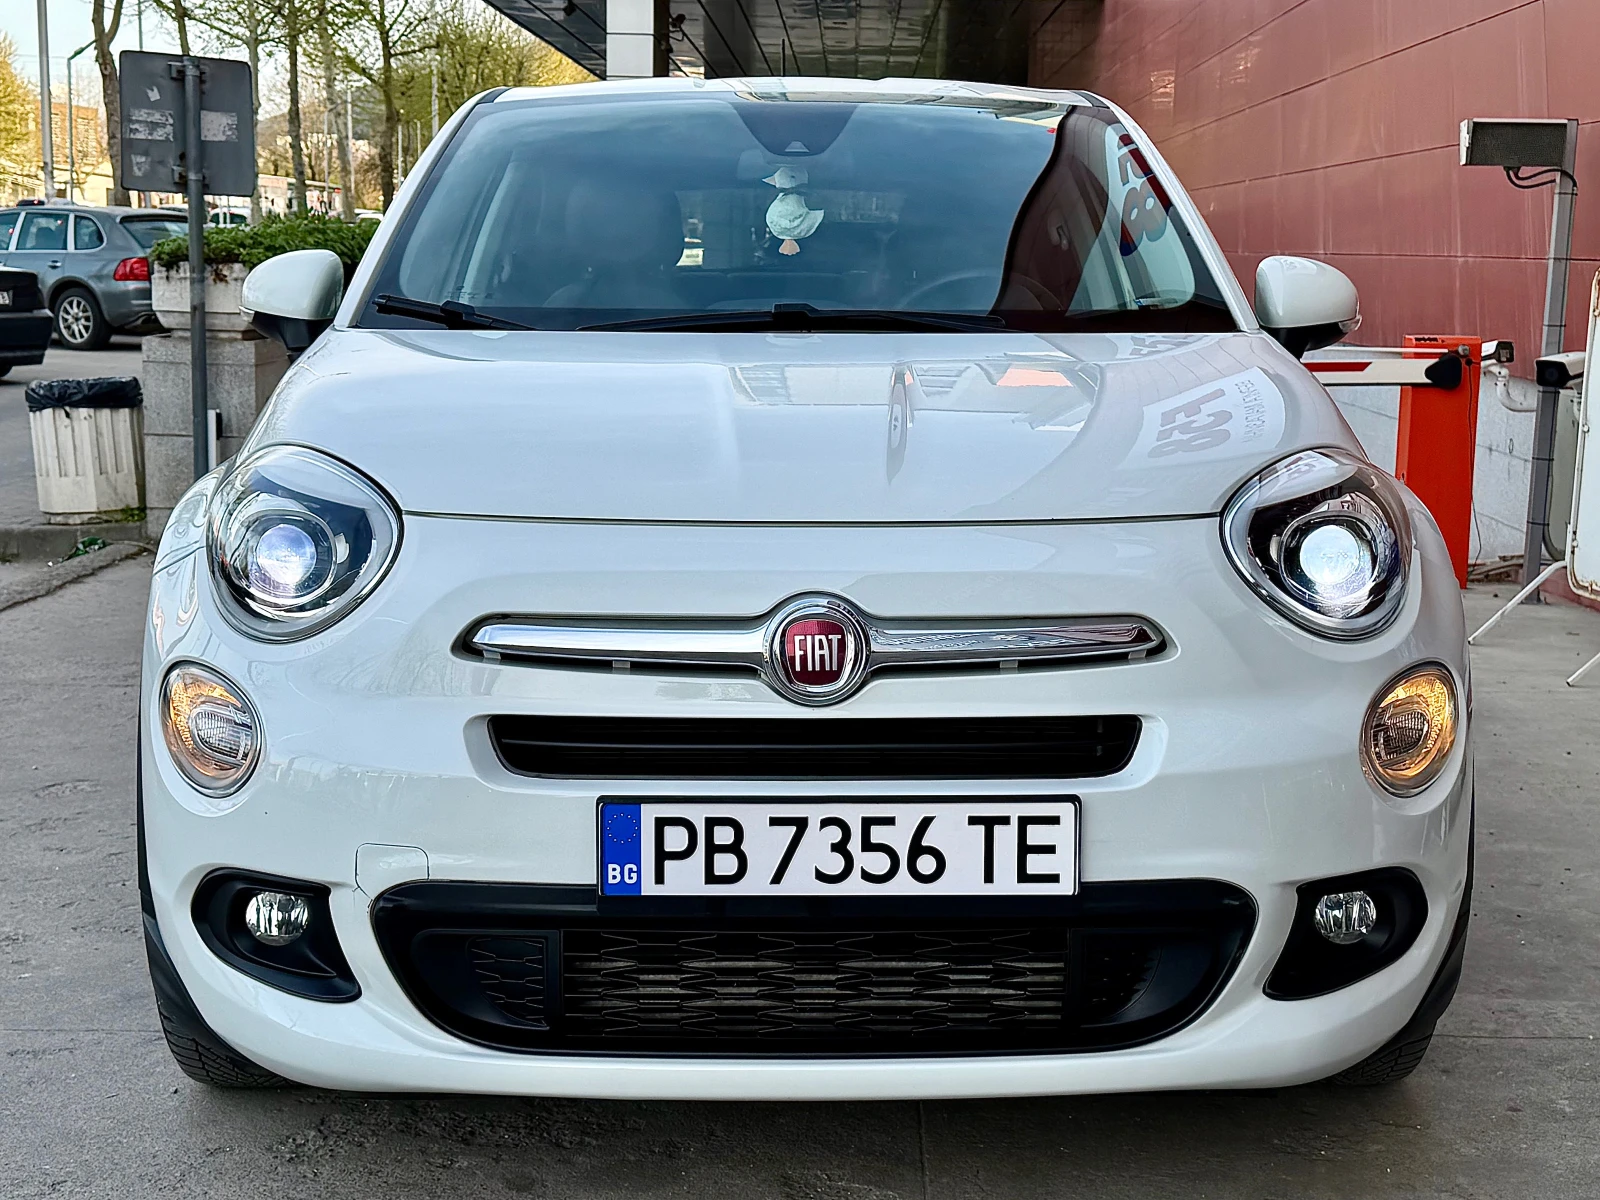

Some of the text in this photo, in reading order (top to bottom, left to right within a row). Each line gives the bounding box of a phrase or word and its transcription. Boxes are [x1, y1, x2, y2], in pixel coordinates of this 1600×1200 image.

[794, 634, 842, 672] FIAT
[653, 815, 1062, 886] PB 7356 TE
[607, 863, 638, 885] BG
